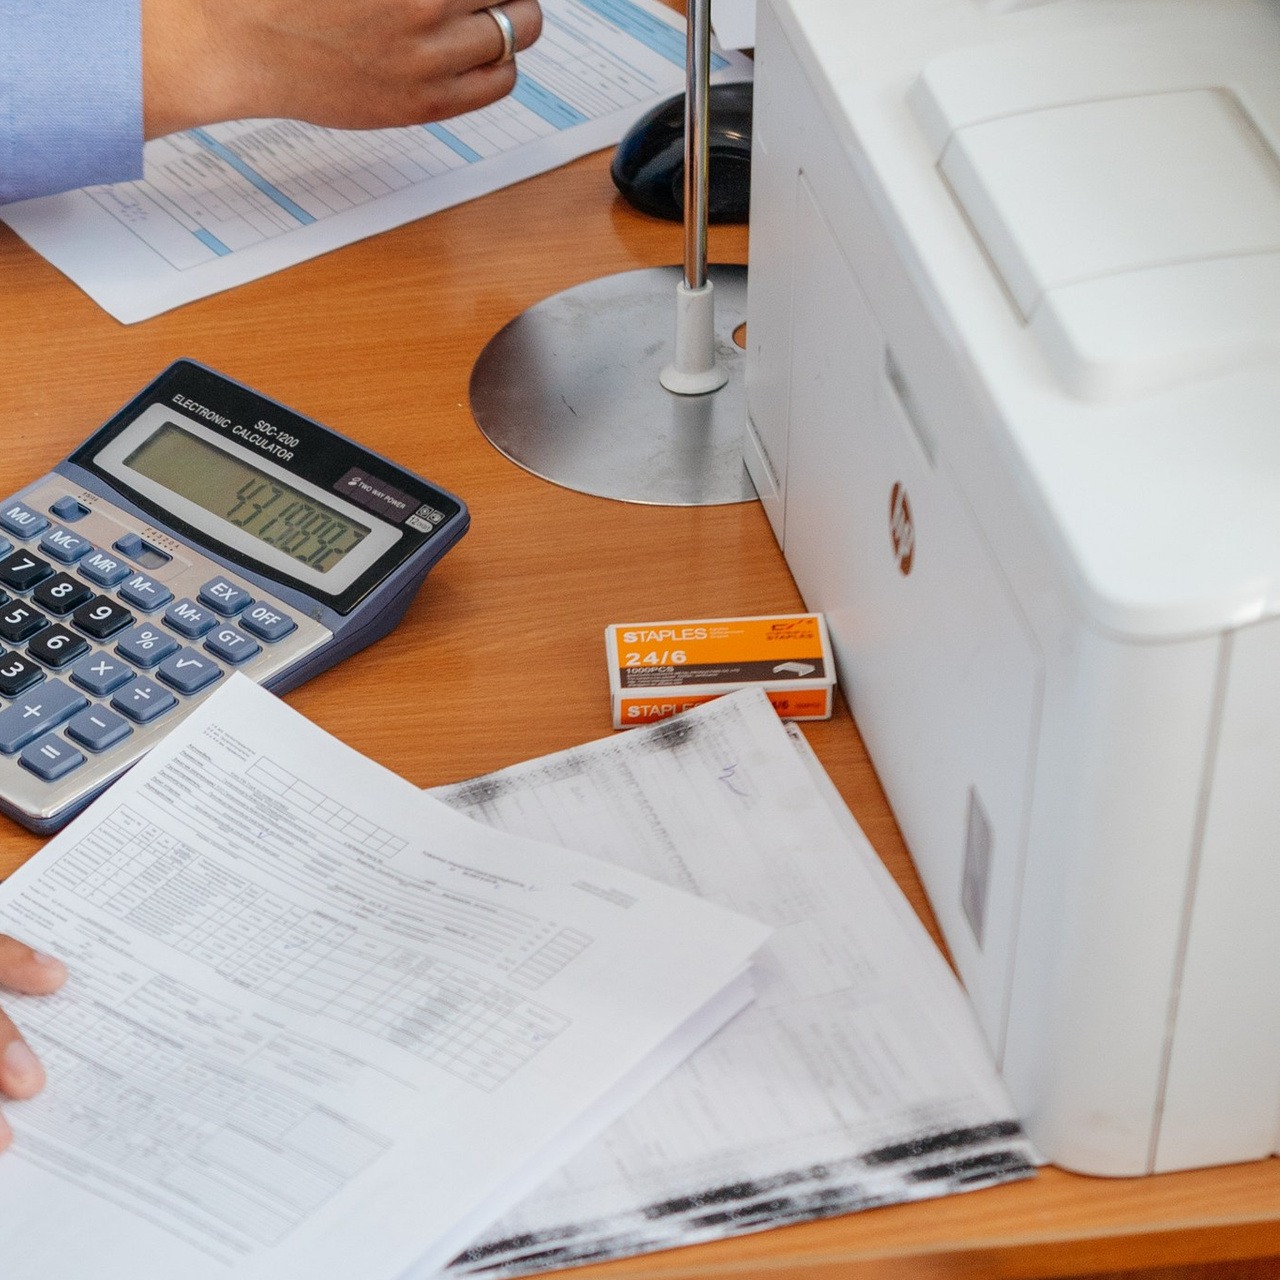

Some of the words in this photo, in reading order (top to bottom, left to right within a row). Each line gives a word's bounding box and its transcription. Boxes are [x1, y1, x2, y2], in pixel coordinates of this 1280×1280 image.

[171, 393, 232, 428] ELECTRONIC
[232, 425, 294, 462] CALCULATOR
[254, 420, 300, 448] SDC-1200
[358, 481, 373, 492] TWO
[371, 488, 385, 499] WAY
[383, 495, 406, 509] POWER
[6, 506, 35, 525] MU
[49, 530, 80, 549] MC
[11, 557, 36, 572] 7
[88, 553, 117, 573] MR
[50, 582, 74, 598] 8
[209, 582, 239, 601] EX
[4, 608, 30, 624] 5
[89, 606, 113, 620] 9
[174, 603, 201, 622] M+
[251, 607, 282, 626] OFF
[46, 635, 70, 650] 6
[218, 630, 245, 647] GT
[623, 627, 708, 643] STAPLES
[625, 650, 687, 666] 24/6
[0, 661, 25, 677] 3
[626, 666, 674, 674] 1000PCS
